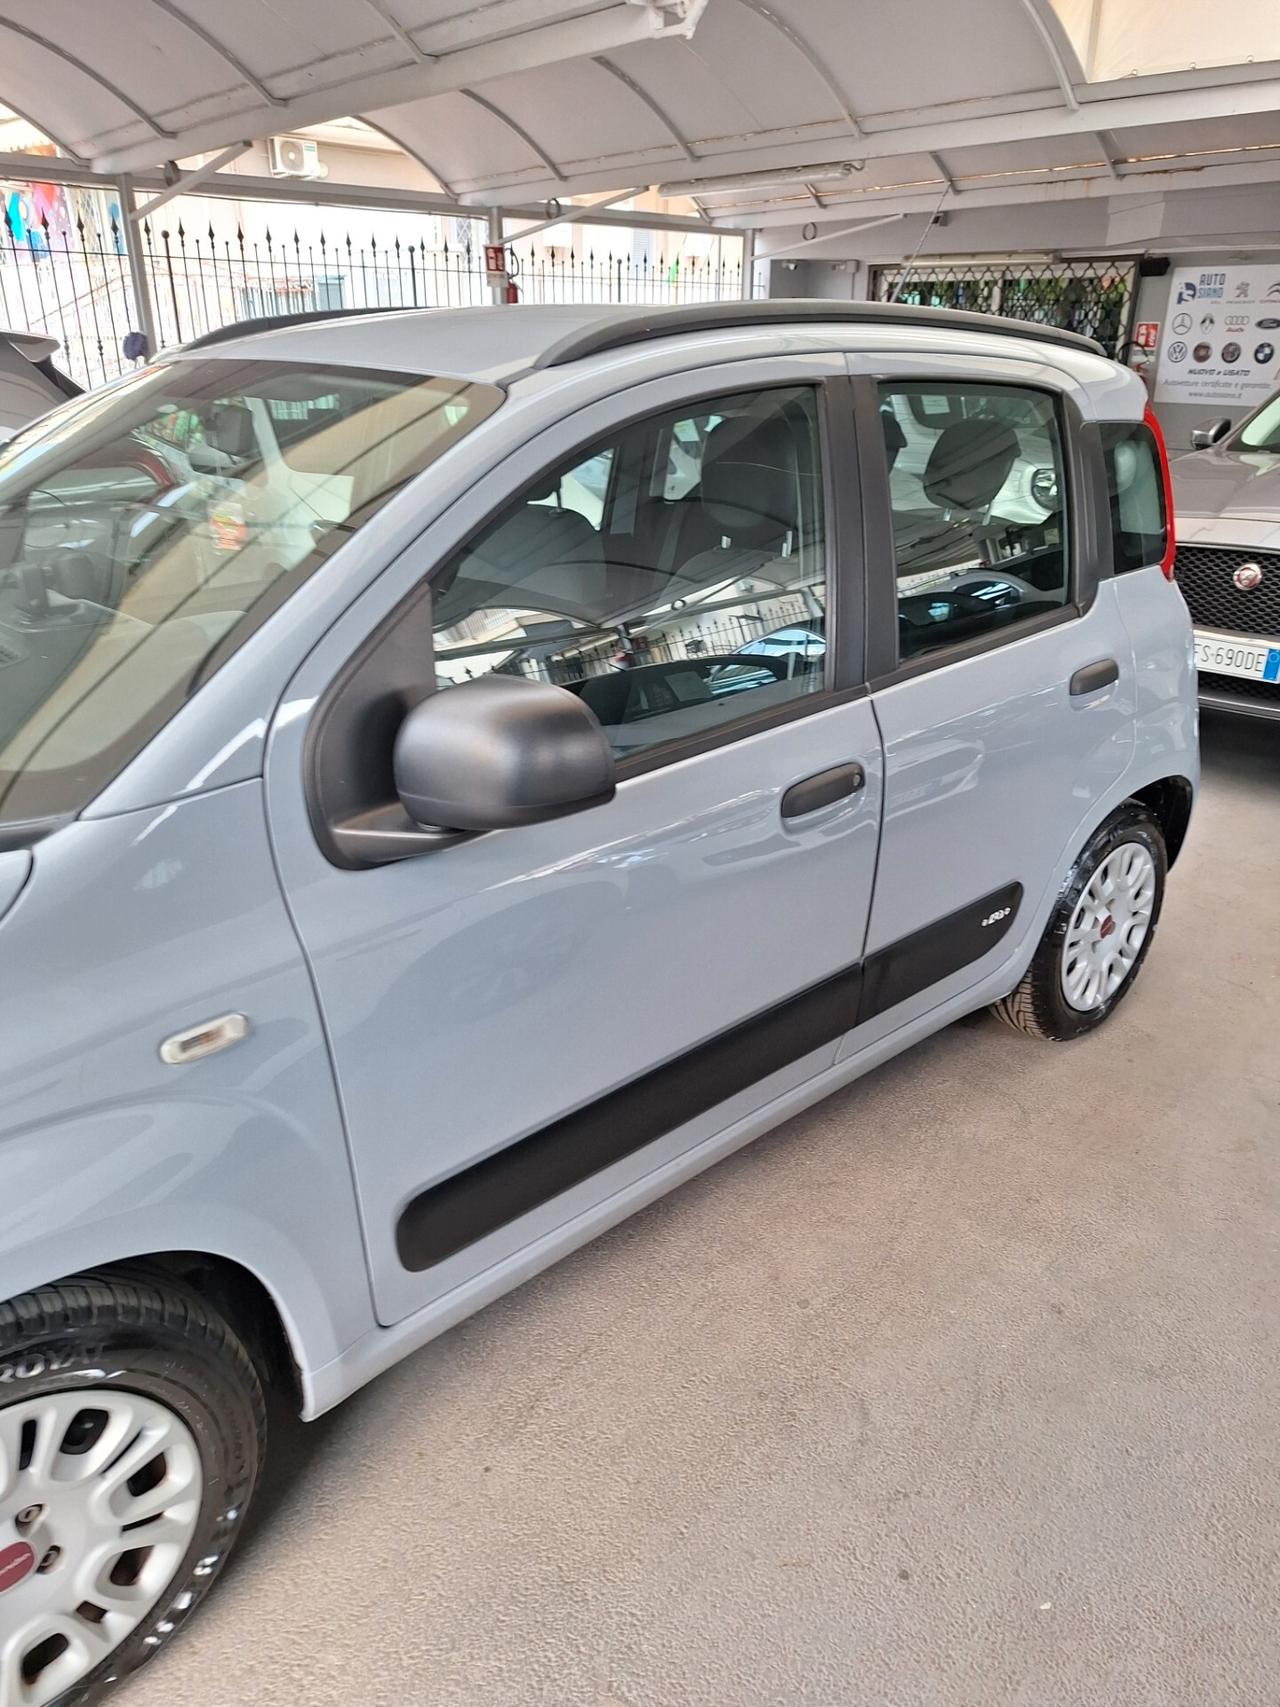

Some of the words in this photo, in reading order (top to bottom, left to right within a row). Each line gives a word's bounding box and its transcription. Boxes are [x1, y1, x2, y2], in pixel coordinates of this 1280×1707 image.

[1199, 273, 1226, 286] AUTO
[1197, 287, 1224, 299] SIANO
[1187, 368, 1216, 376] NUOVO
[1222, 369, 1251, 377] USATO
